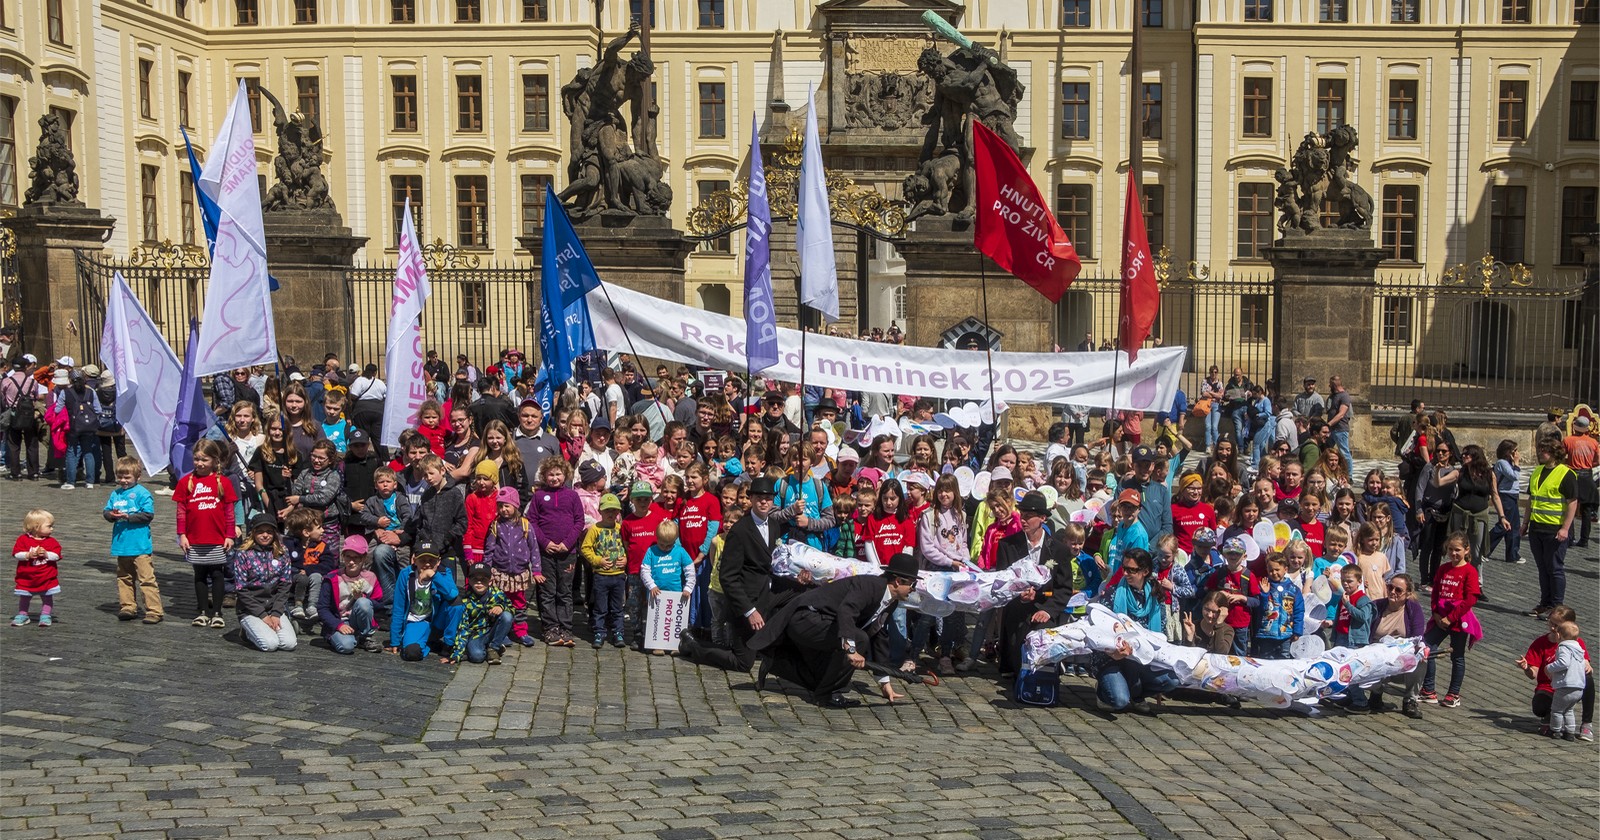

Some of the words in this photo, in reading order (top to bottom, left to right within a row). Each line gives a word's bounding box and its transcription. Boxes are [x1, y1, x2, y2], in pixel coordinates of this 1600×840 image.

[993, 199, 1021, 225] PRO
[1036, 249, 1056, 271] ČR
[818, 356, 972, 391] miminek
[980, 368, 1075, 393] 2025
[665, 599, 674, 617] PRO
[663, 617, 674, 643] ŽIVOT
[674, 603, 684, 640] POCHOD
